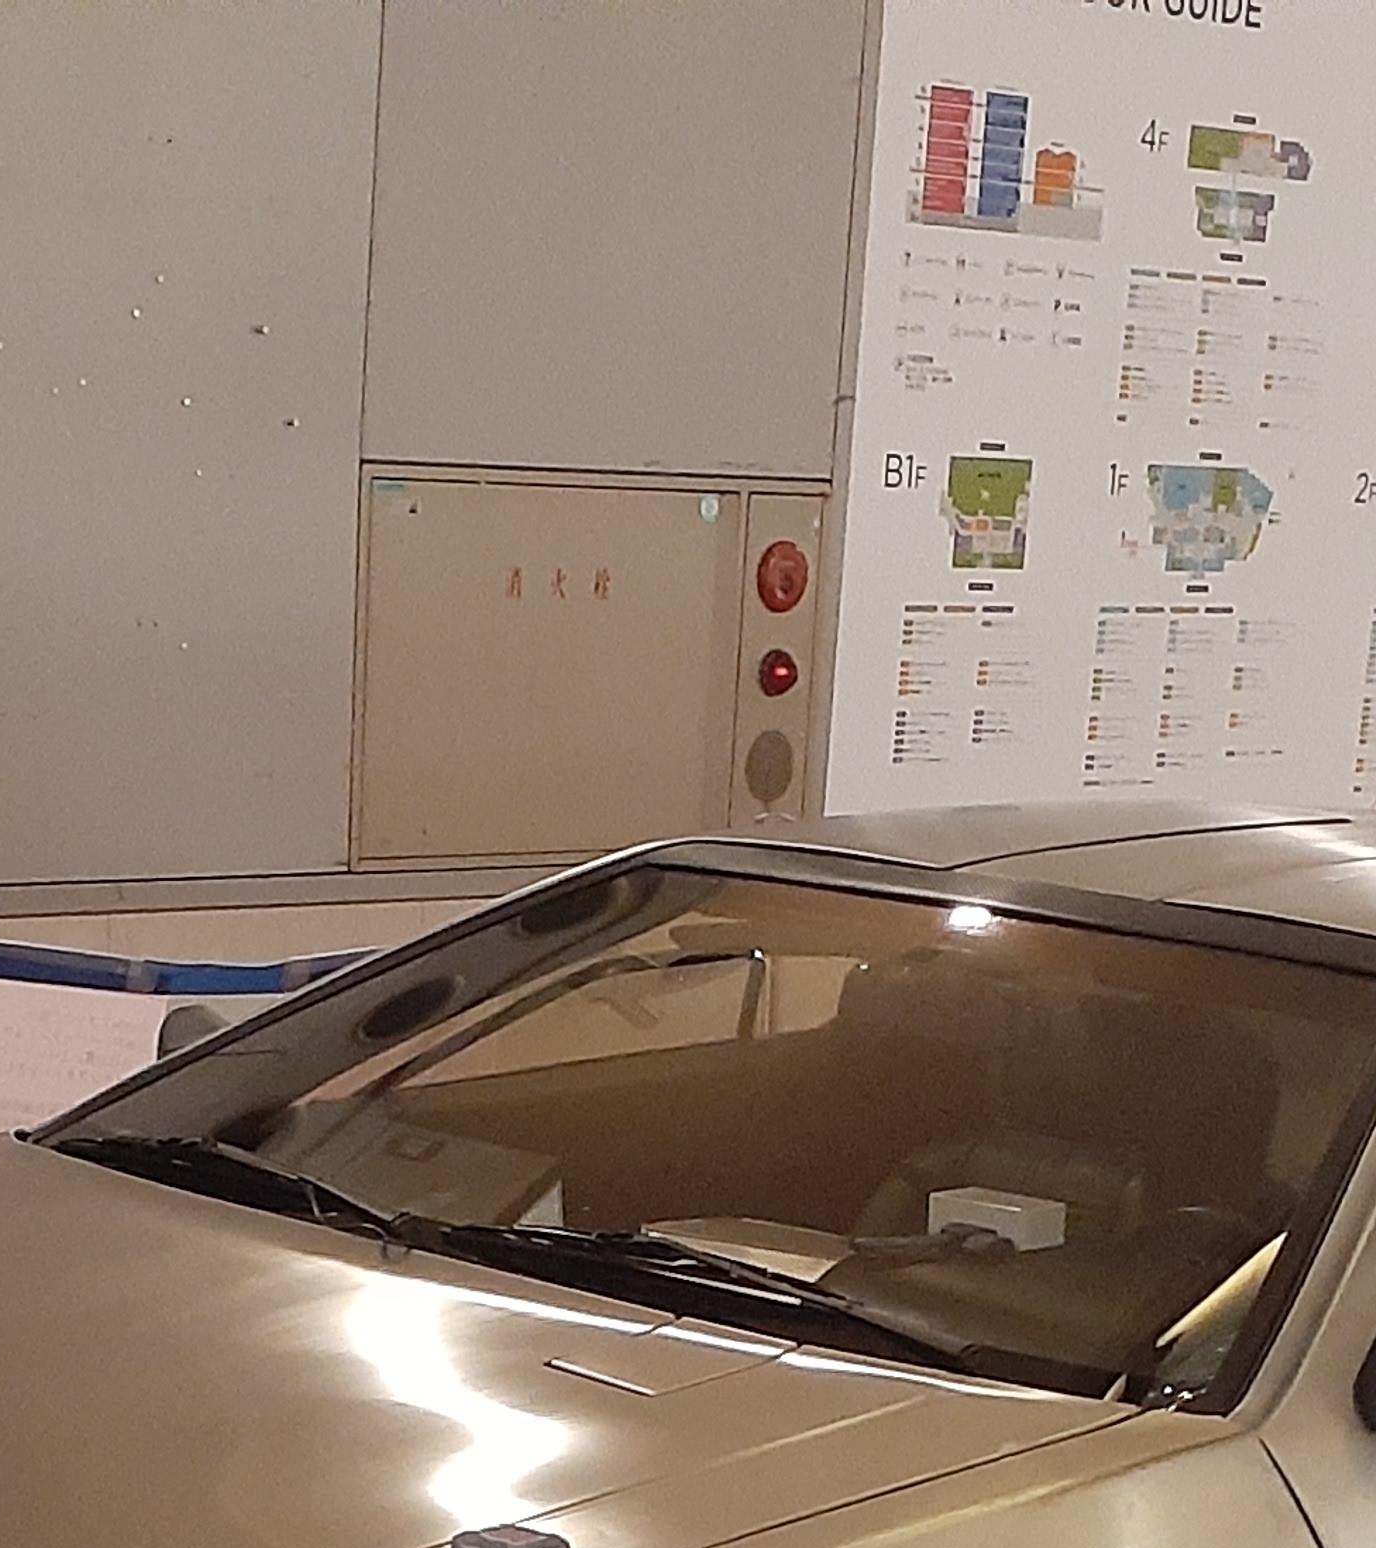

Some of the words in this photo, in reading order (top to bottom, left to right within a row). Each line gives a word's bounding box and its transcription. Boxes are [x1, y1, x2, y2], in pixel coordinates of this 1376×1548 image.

[1140, 119, 1170, 152] 4F
[884, 453, 927, 488] B1F
[1109, 462, 1129, 497] 1F
